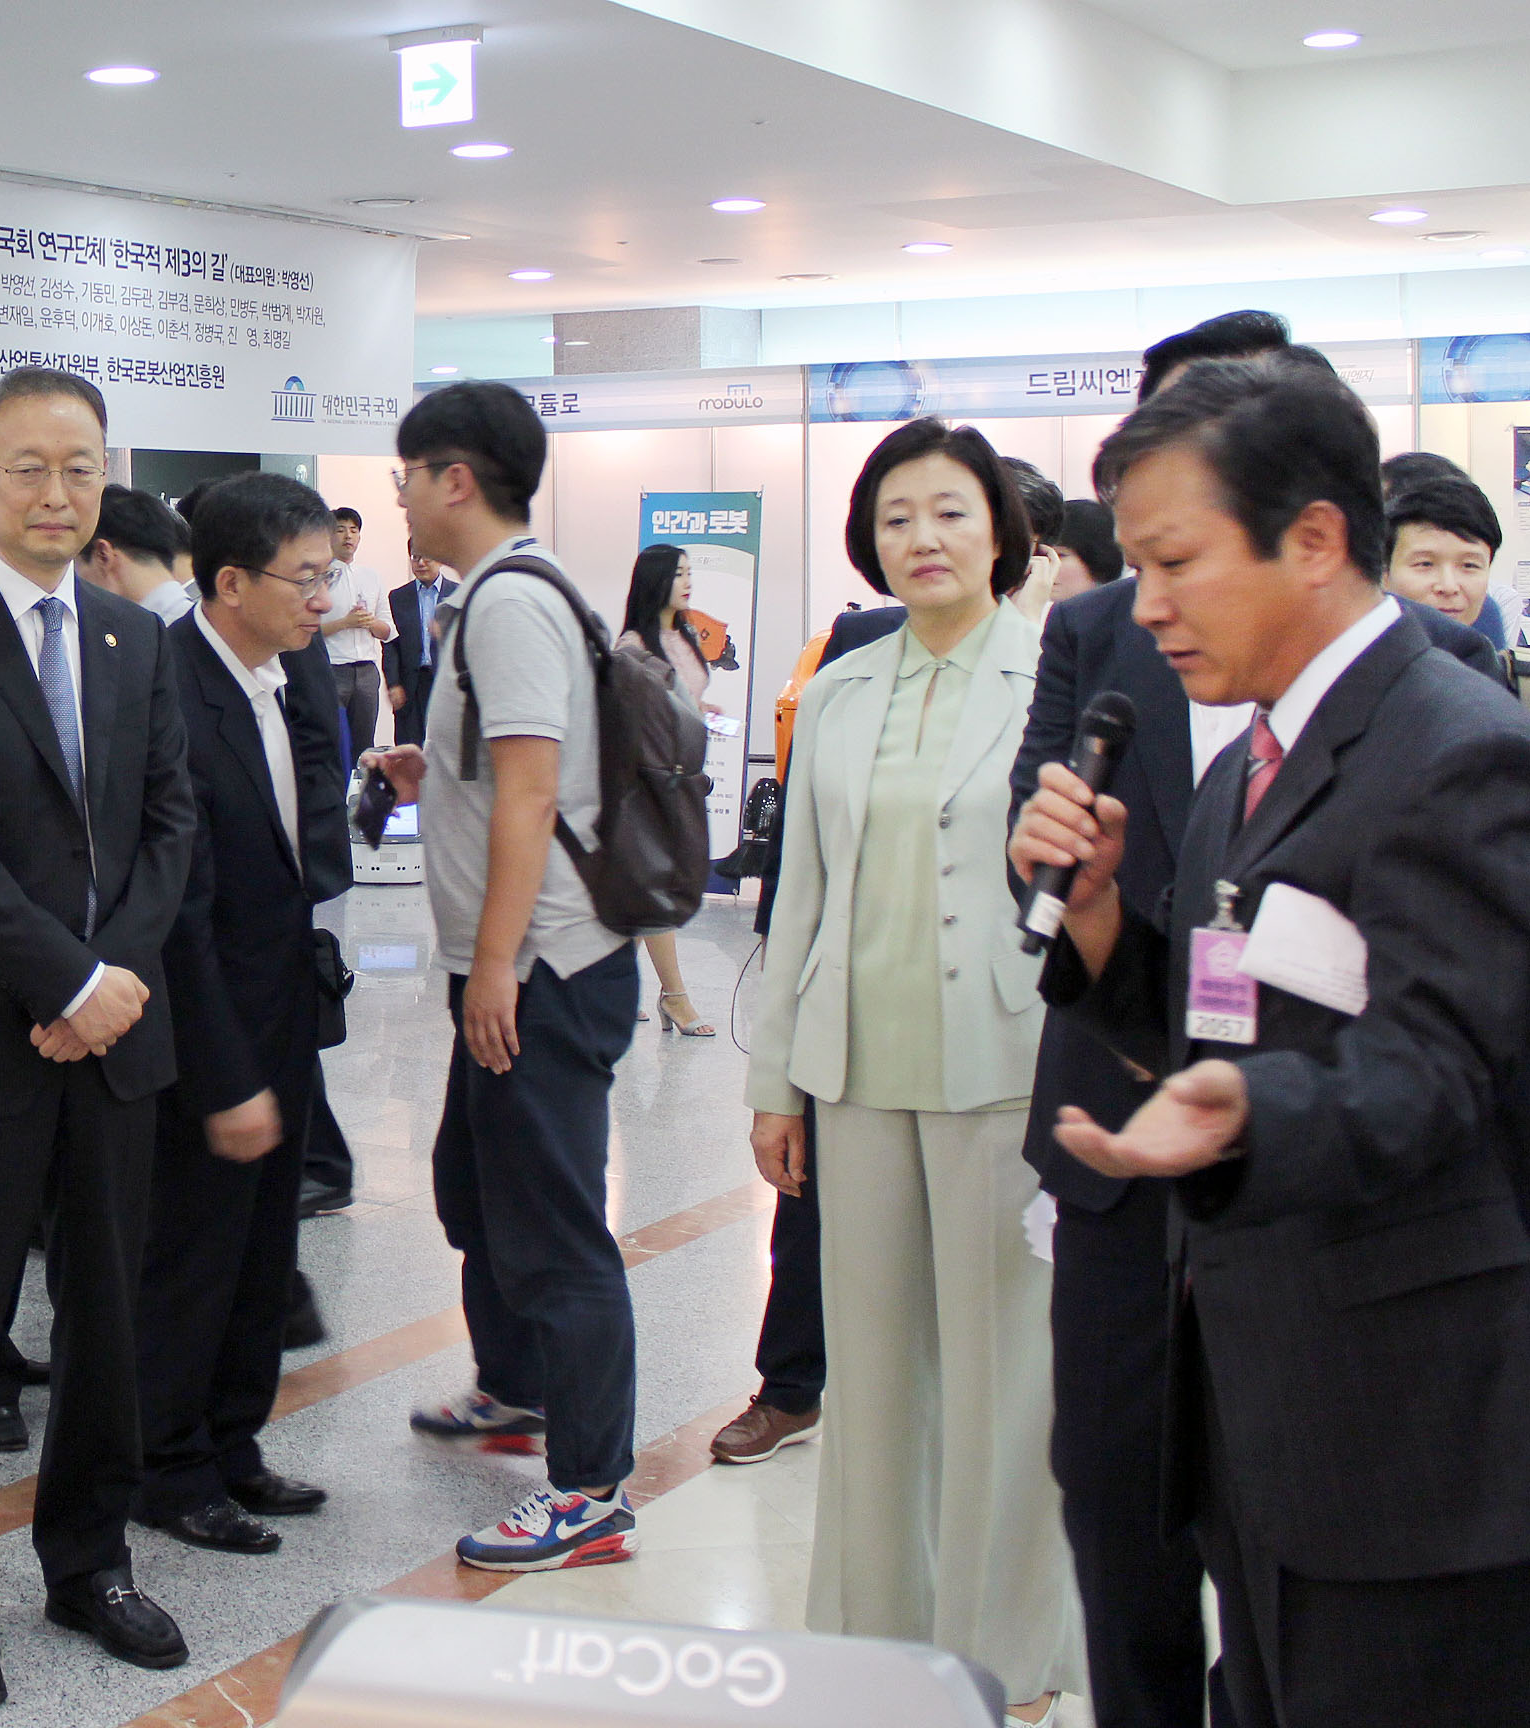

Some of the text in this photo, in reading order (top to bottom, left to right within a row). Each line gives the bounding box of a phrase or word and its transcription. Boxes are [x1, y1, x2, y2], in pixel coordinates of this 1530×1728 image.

[38, 231, 106, 267] 연구단체
[165, 247, 206, 279] 제3의
[1, 273, 326, 327] 박영선, 김성수, 기동민, 김두관, 김부겸, 문희상, 민병두, 박범계, 박지원,
[40, 307, 78, 332] 윤후덕,
[82, 311, 117, 336] 이개호,
[120, 314, 155, 340] 이상돈,
[158, 319, 191, 343] 이춘석,
[194, 322, 224, 346] 정병국,
[263, 328, 291, 350] 최명길
[107, 356, 225, 390] 한국로봇산업진흥원
[651, 509, 749, 535] 인간과 로봇
[519, 1627, 787, 1709] GoCart
